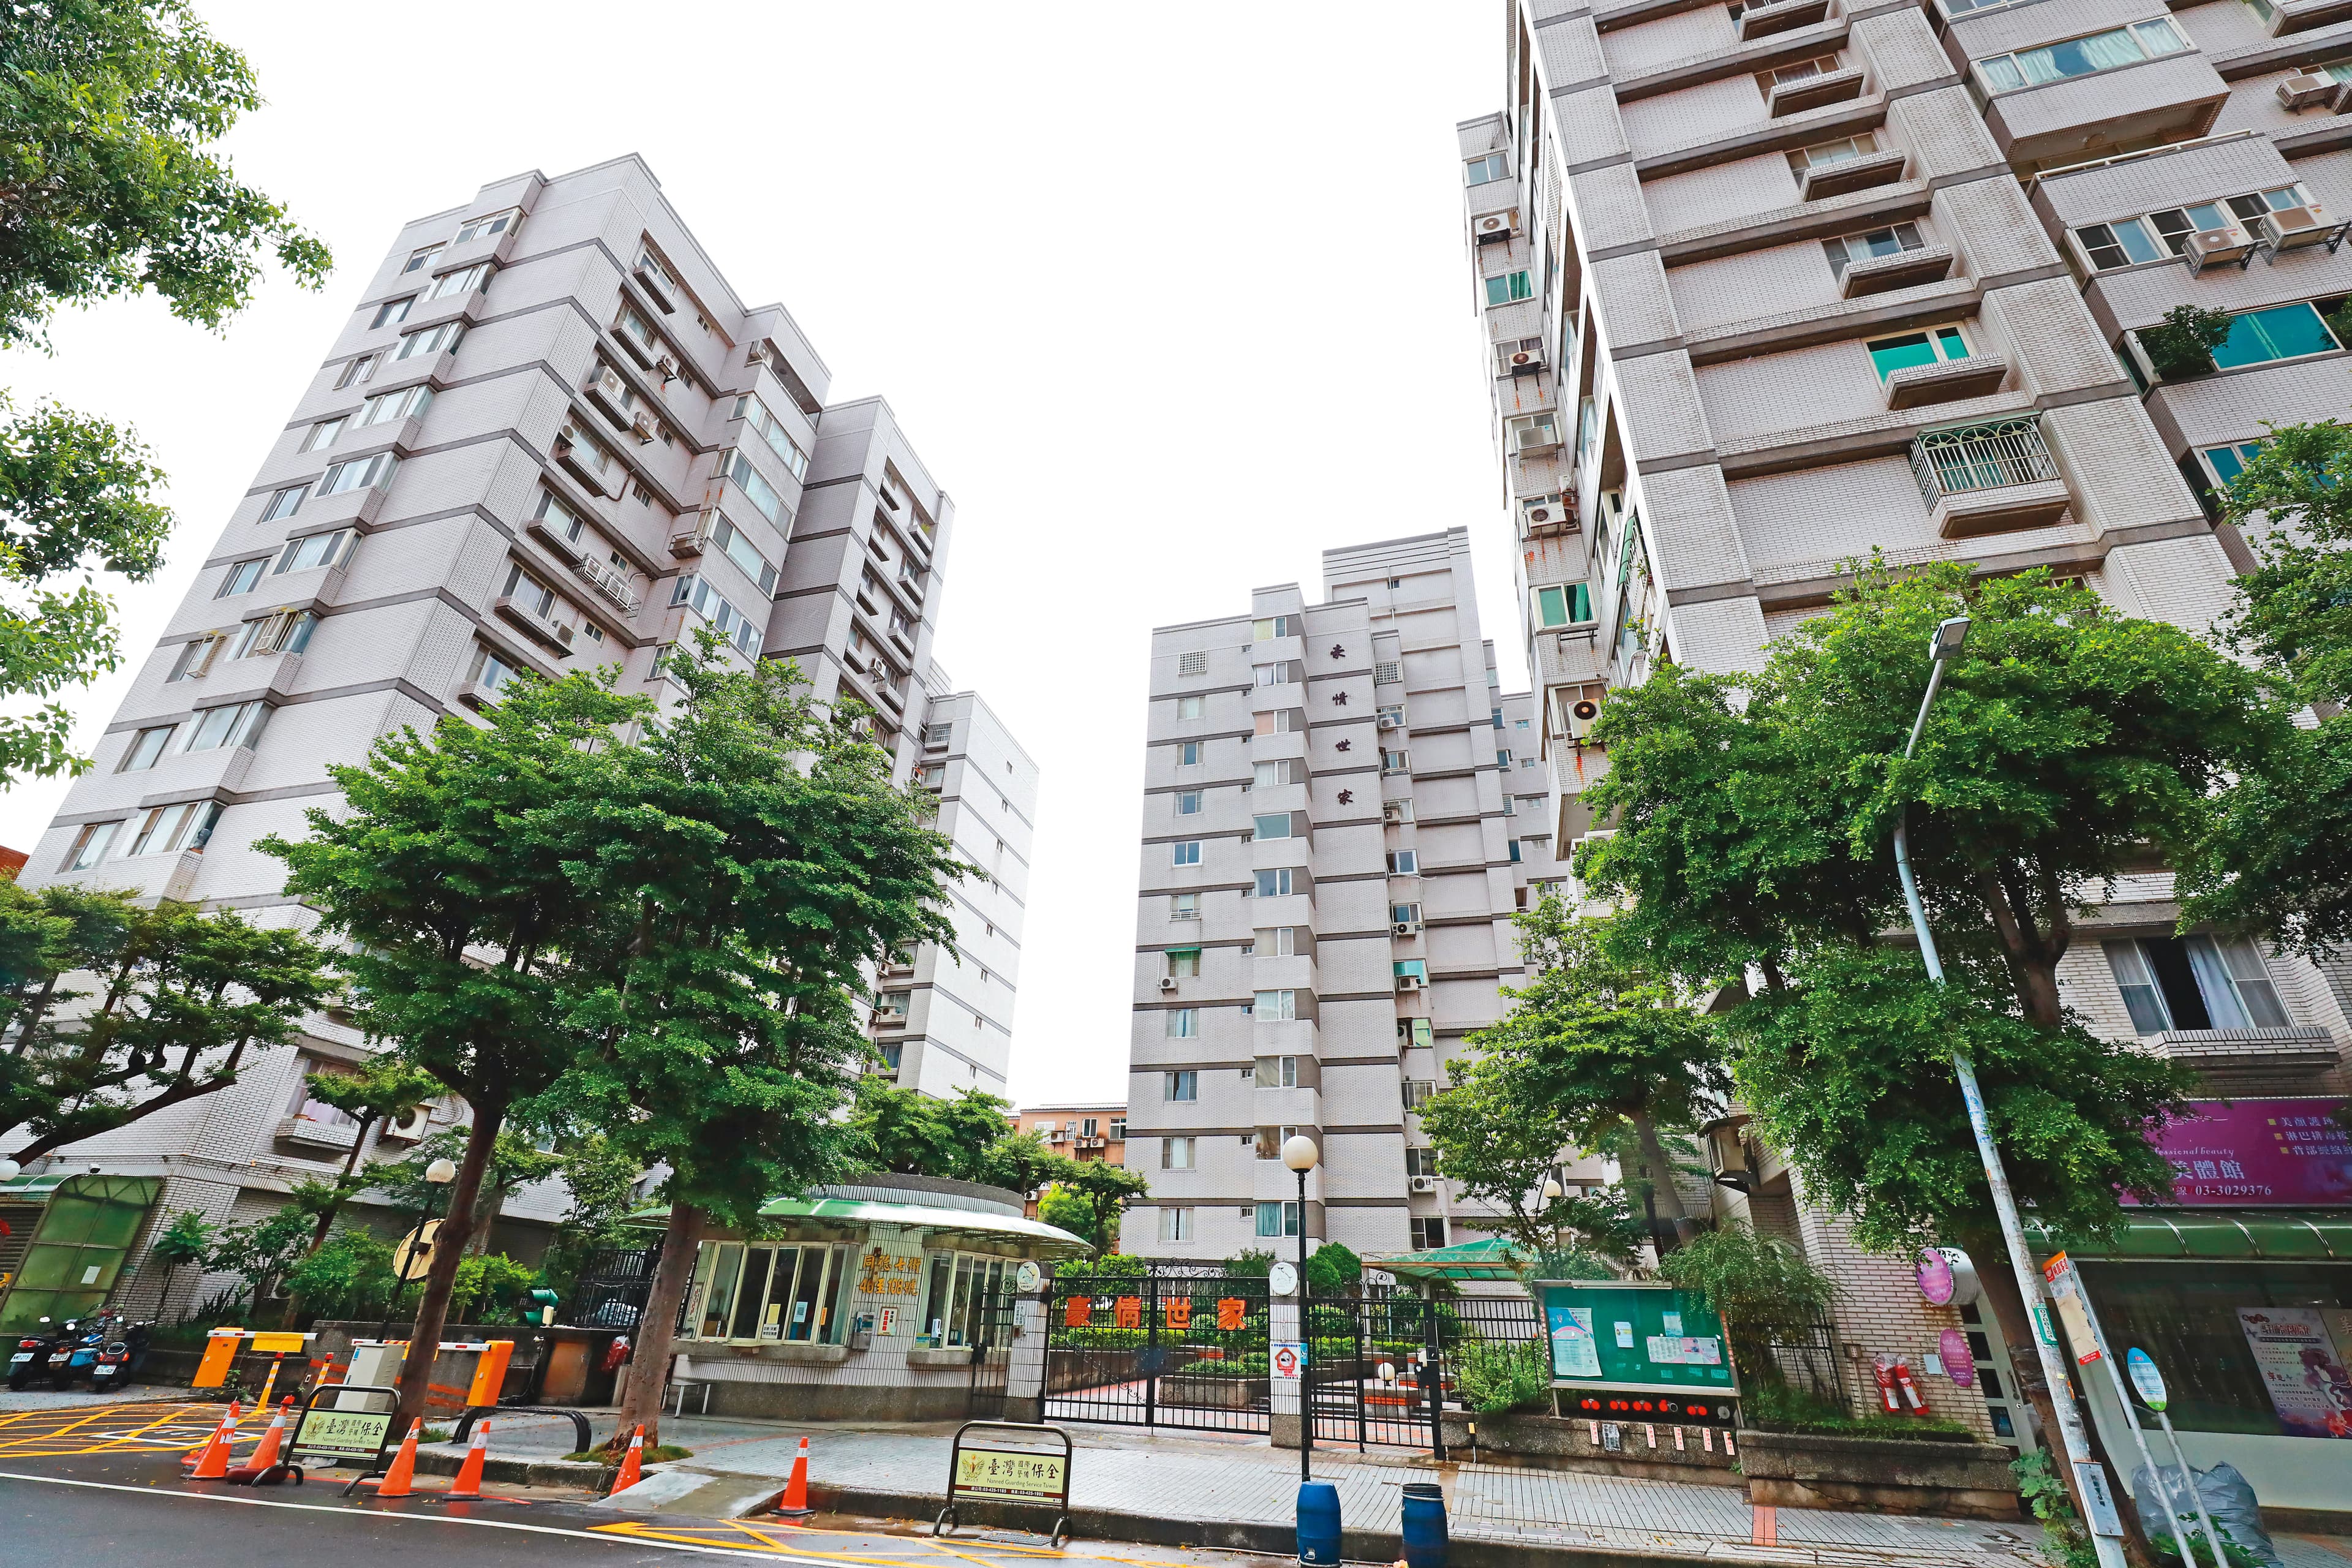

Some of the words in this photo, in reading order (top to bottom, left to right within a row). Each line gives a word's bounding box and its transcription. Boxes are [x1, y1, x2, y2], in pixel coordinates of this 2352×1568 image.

[1330, 644, 1353, 805] 豪情世家
[2154, 1146, 2198, 1156] fessional
[2195, 1185, 2272, 1196] 03-3029376
[862, 1254, 922, 1273] 同德七街
[1065, 1295, 1247, 1331] 豪情世家
[326, 1418, 350, 1435] 臺灣
[360, 1422, 383, 1436] 保全
[988, 1458, 1016, 1477] 臺灣
[1031, 1463, 1059, 1479] 保全
[1005, 1479, 1025, 1488] Guarding
